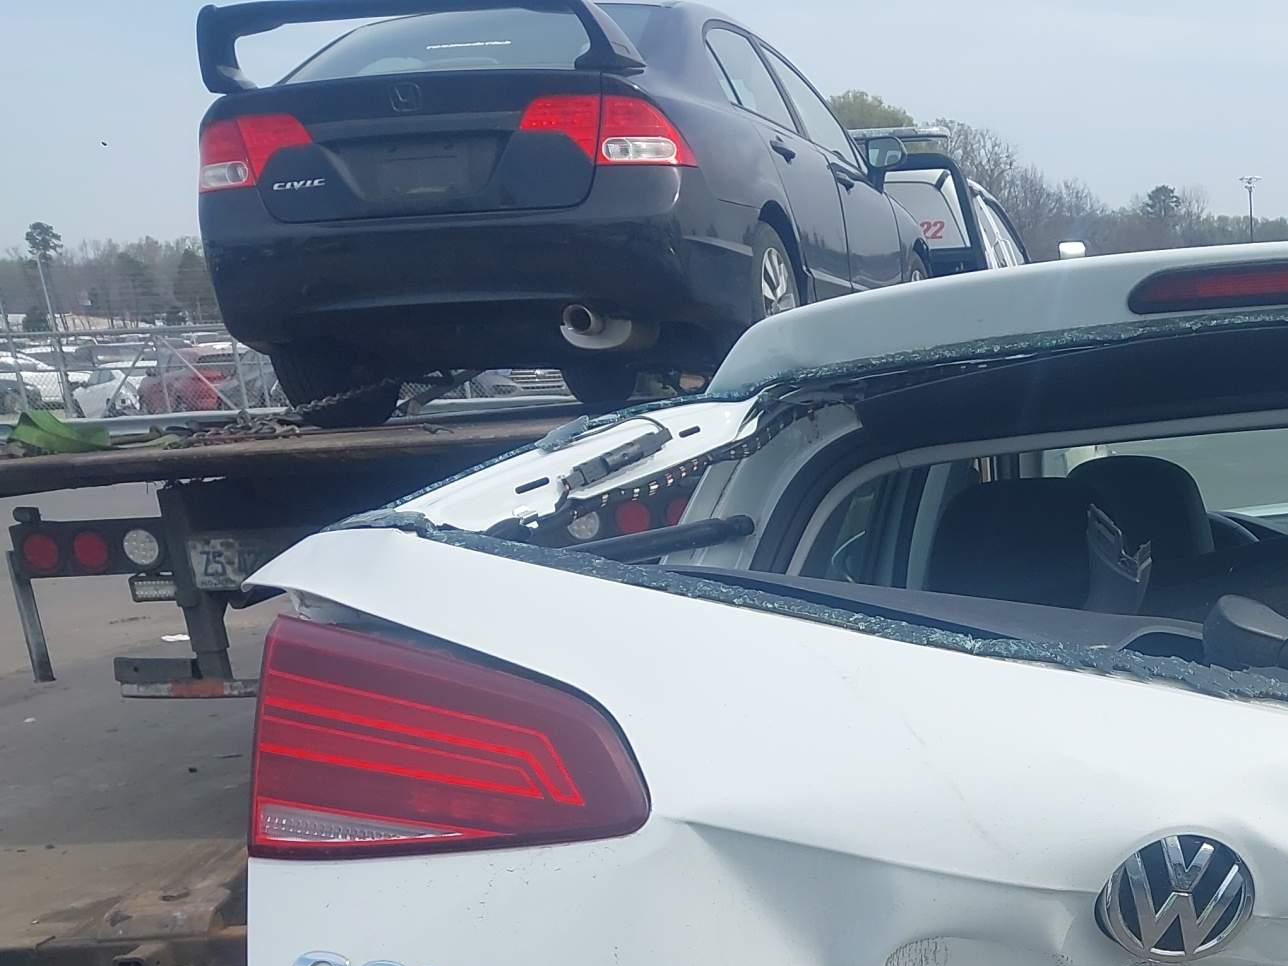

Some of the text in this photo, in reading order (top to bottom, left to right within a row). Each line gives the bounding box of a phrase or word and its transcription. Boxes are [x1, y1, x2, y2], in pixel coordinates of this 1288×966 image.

[272, 178, 326, 191] CIVIC
[919, 220, 945, 240] 22
[1112, 836, 1250, 958] VW
